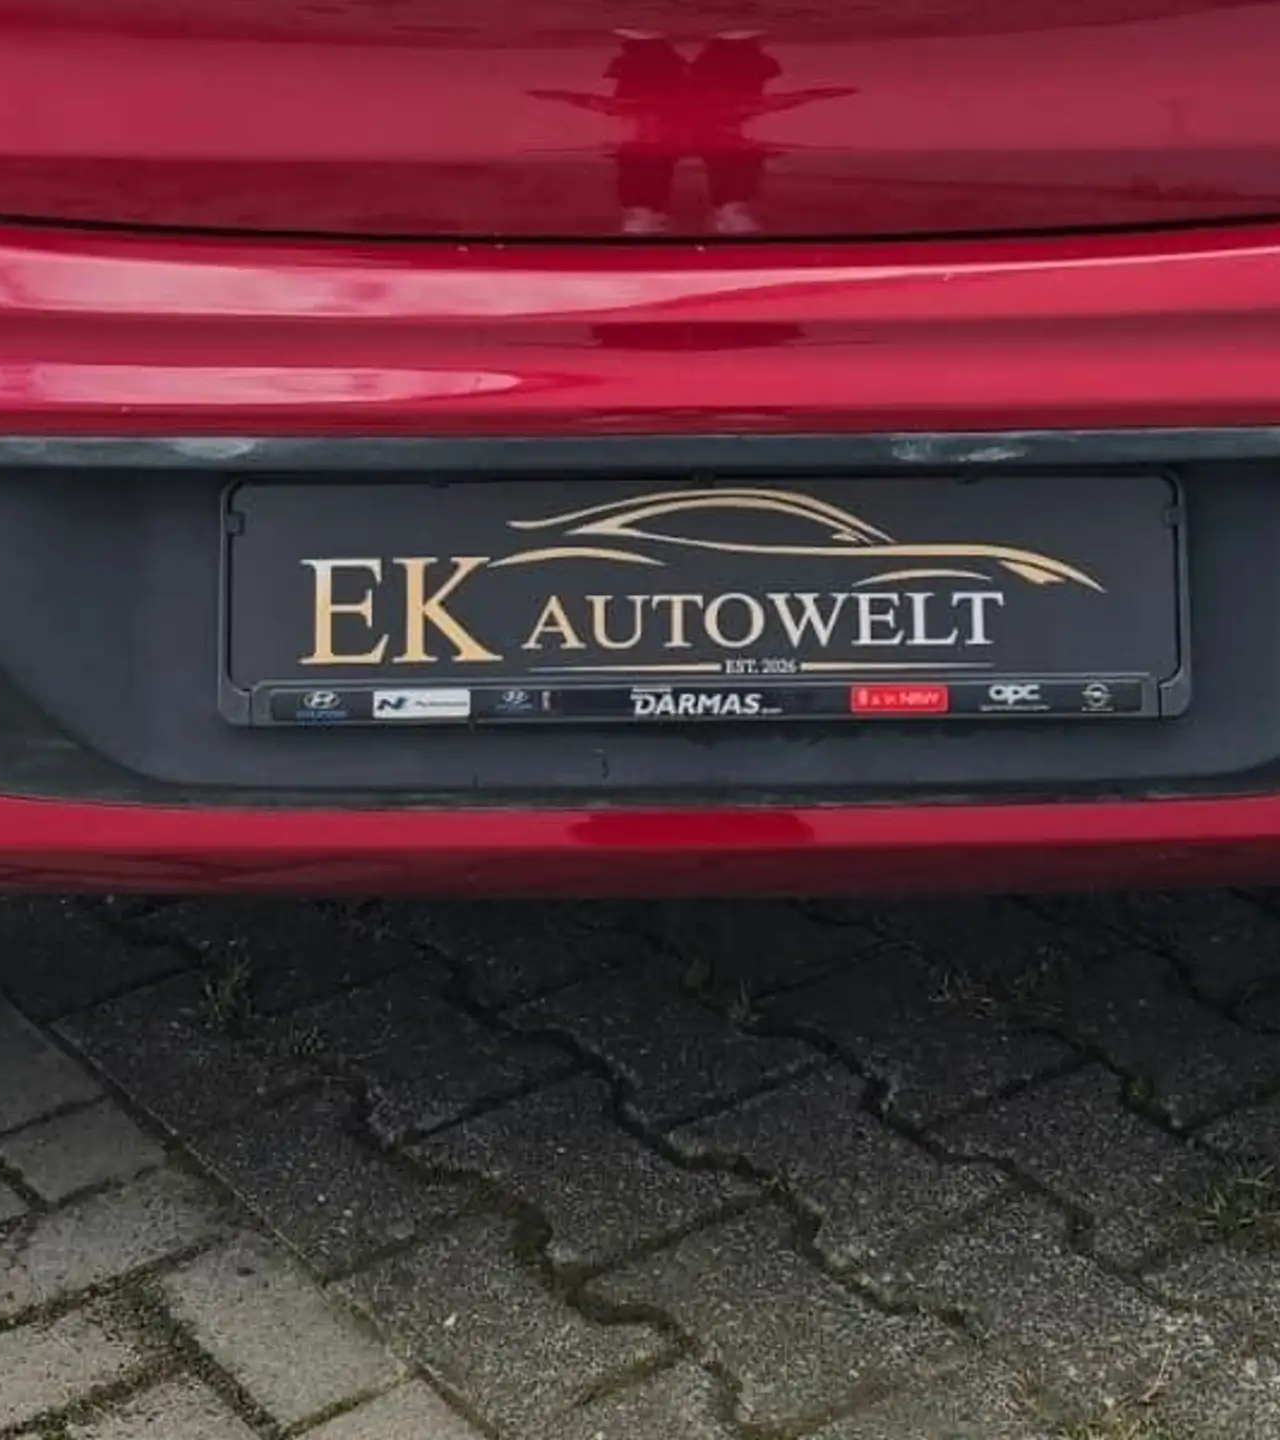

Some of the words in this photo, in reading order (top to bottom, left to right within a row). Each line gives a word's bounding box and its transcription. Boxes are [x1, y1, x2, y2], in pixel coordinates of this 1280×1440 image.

[300, 556, 502, 665] EK
[521, 592, 1004, 650] AUTOWELT
[725, 659, 759, 674] EST.
[634, 693, 762, 715] DARMAS
